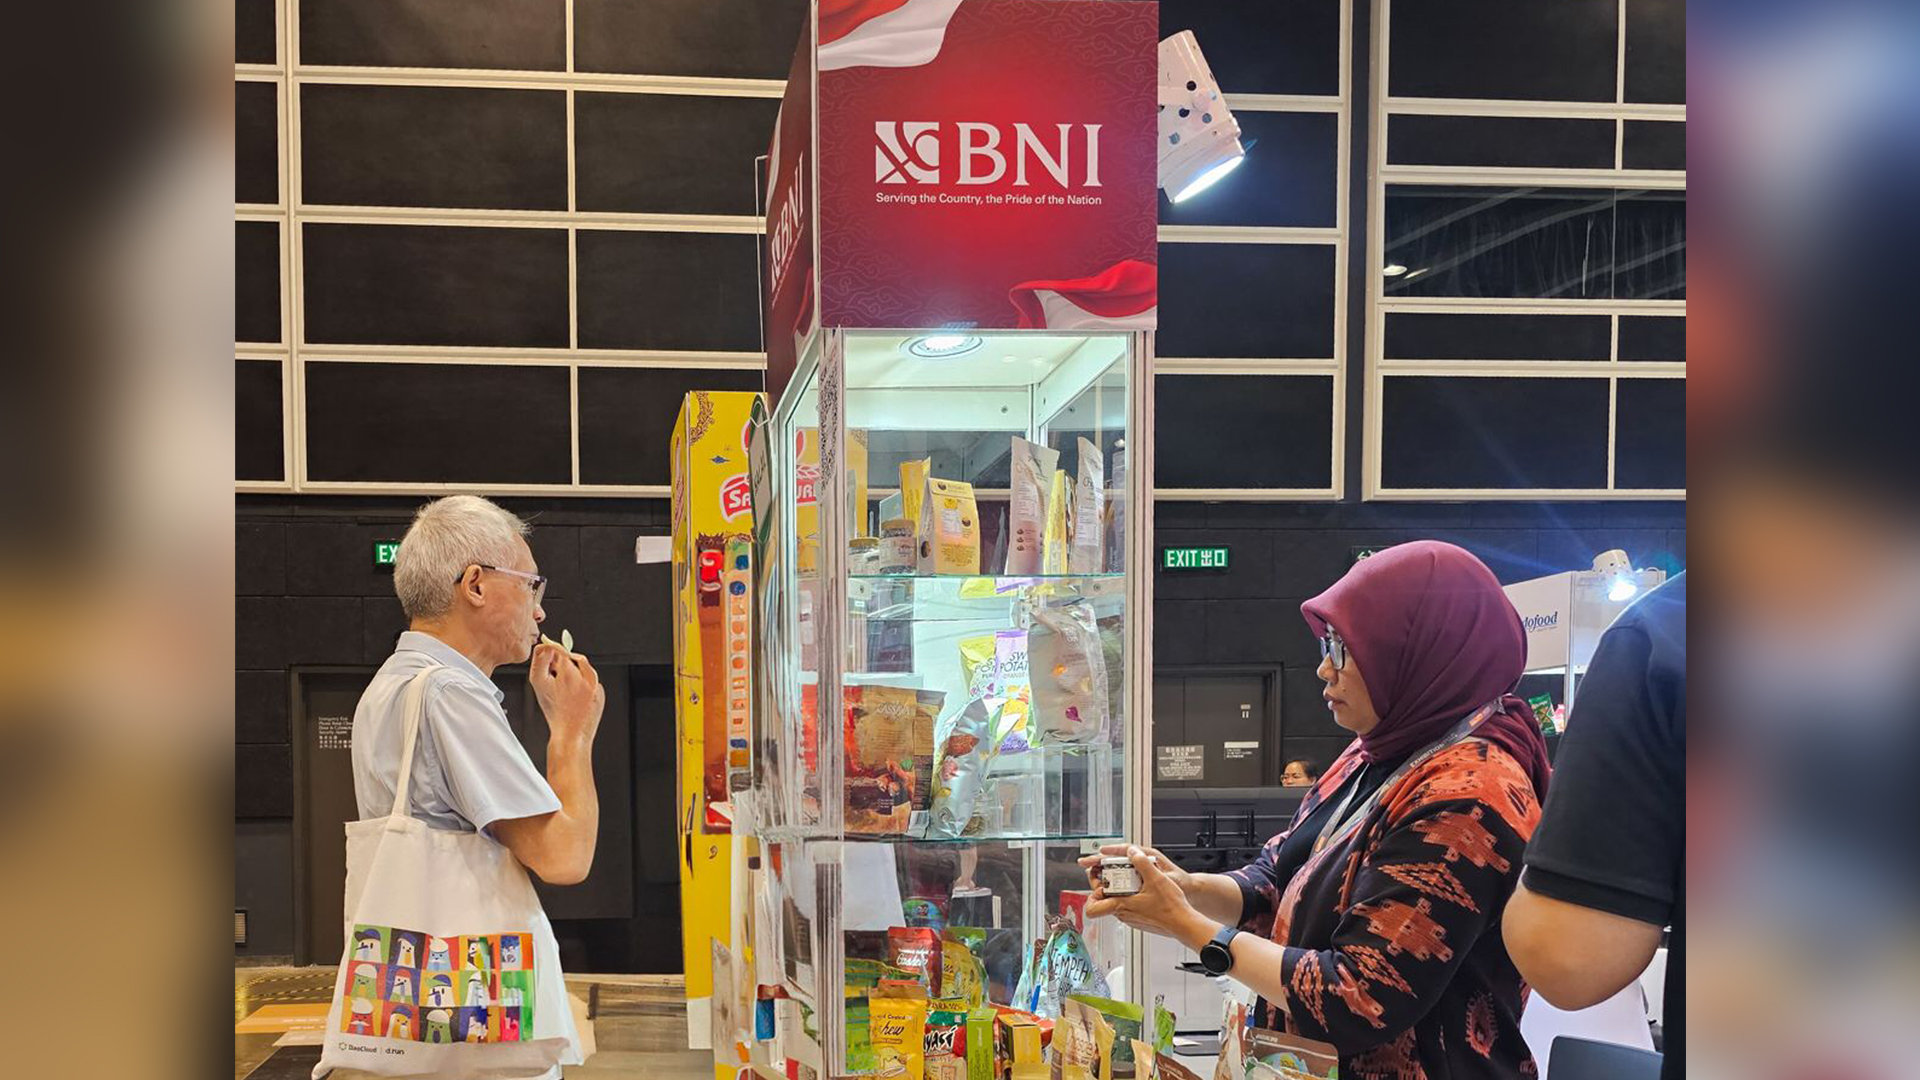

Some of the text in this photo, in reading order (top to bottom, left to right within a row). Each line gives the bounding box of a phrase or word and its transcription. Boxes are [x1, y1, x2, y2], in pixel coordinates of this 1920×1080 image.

[955, 121, 1103, 188] BNI
[875, 192, 1102, 205] Serving the Country, the Pride of the Nation
[781, 152, 804, 266] BNI
[1167, 550, 1197, 567] EXIT
[1201, 550, 1225, 567] 出口
